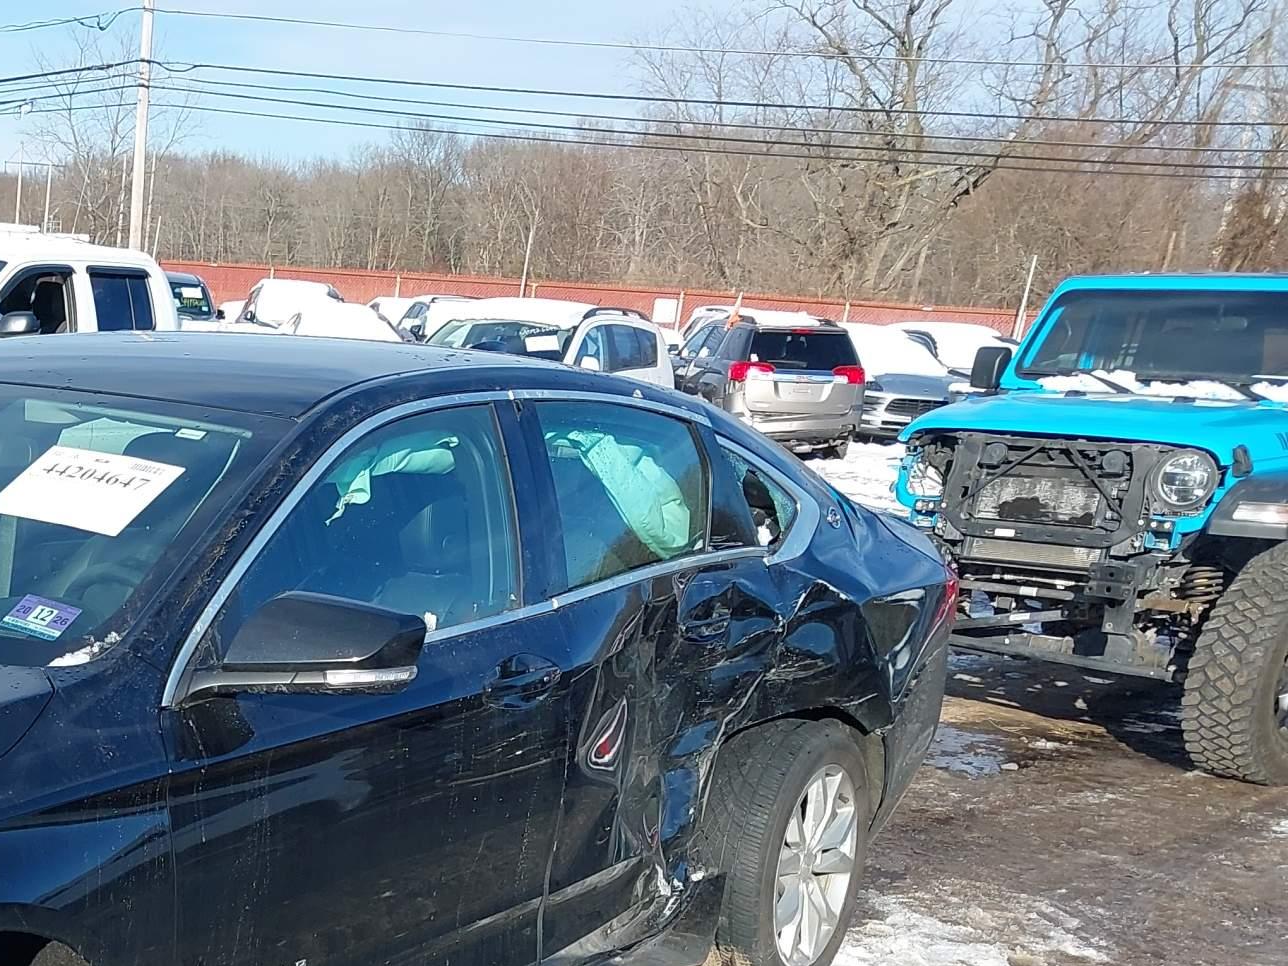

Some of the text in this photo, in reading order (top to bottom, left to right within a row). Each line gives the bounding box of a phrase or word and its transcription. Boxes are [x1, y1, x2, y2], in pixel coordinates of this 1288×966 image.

[42, 463, 151, 490] 44204647
[16, 605, 32, 614] 20
[32, 608, 54, 621] 12
[53, 616, 70, 626] 26
